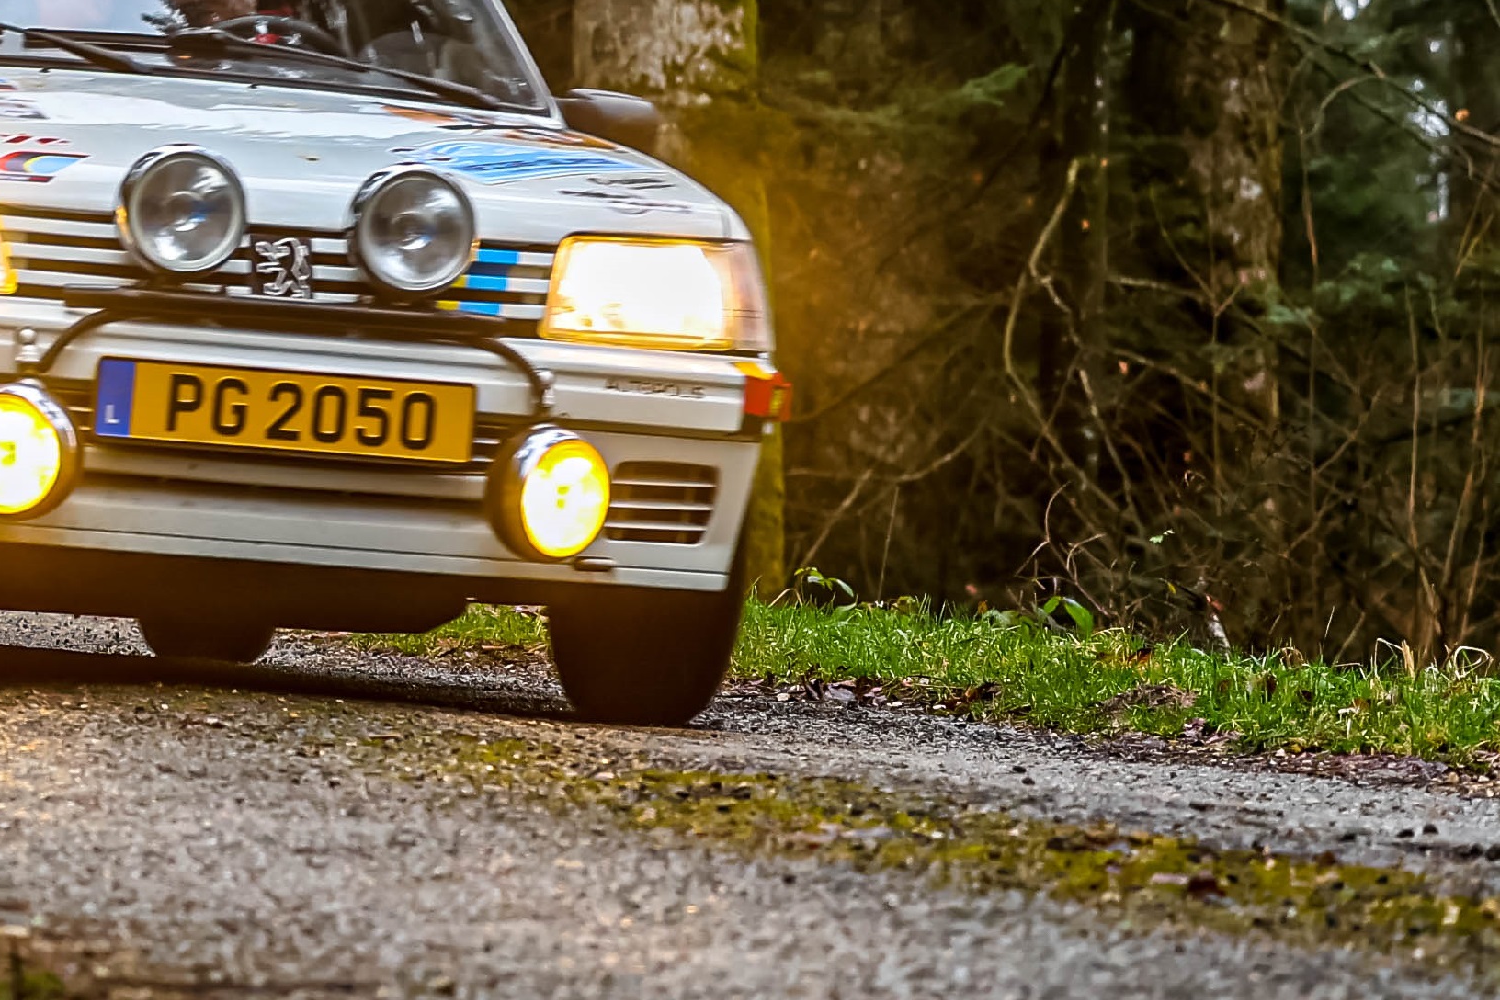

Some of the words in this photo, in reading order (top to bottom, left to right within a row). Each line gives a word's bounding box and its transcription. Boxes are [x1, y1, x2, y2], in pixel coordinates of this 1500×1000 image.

[104, 404, 120, 425] L
[164, 373, 249, 437] PG
[265, 381, 437, 451] 2050
